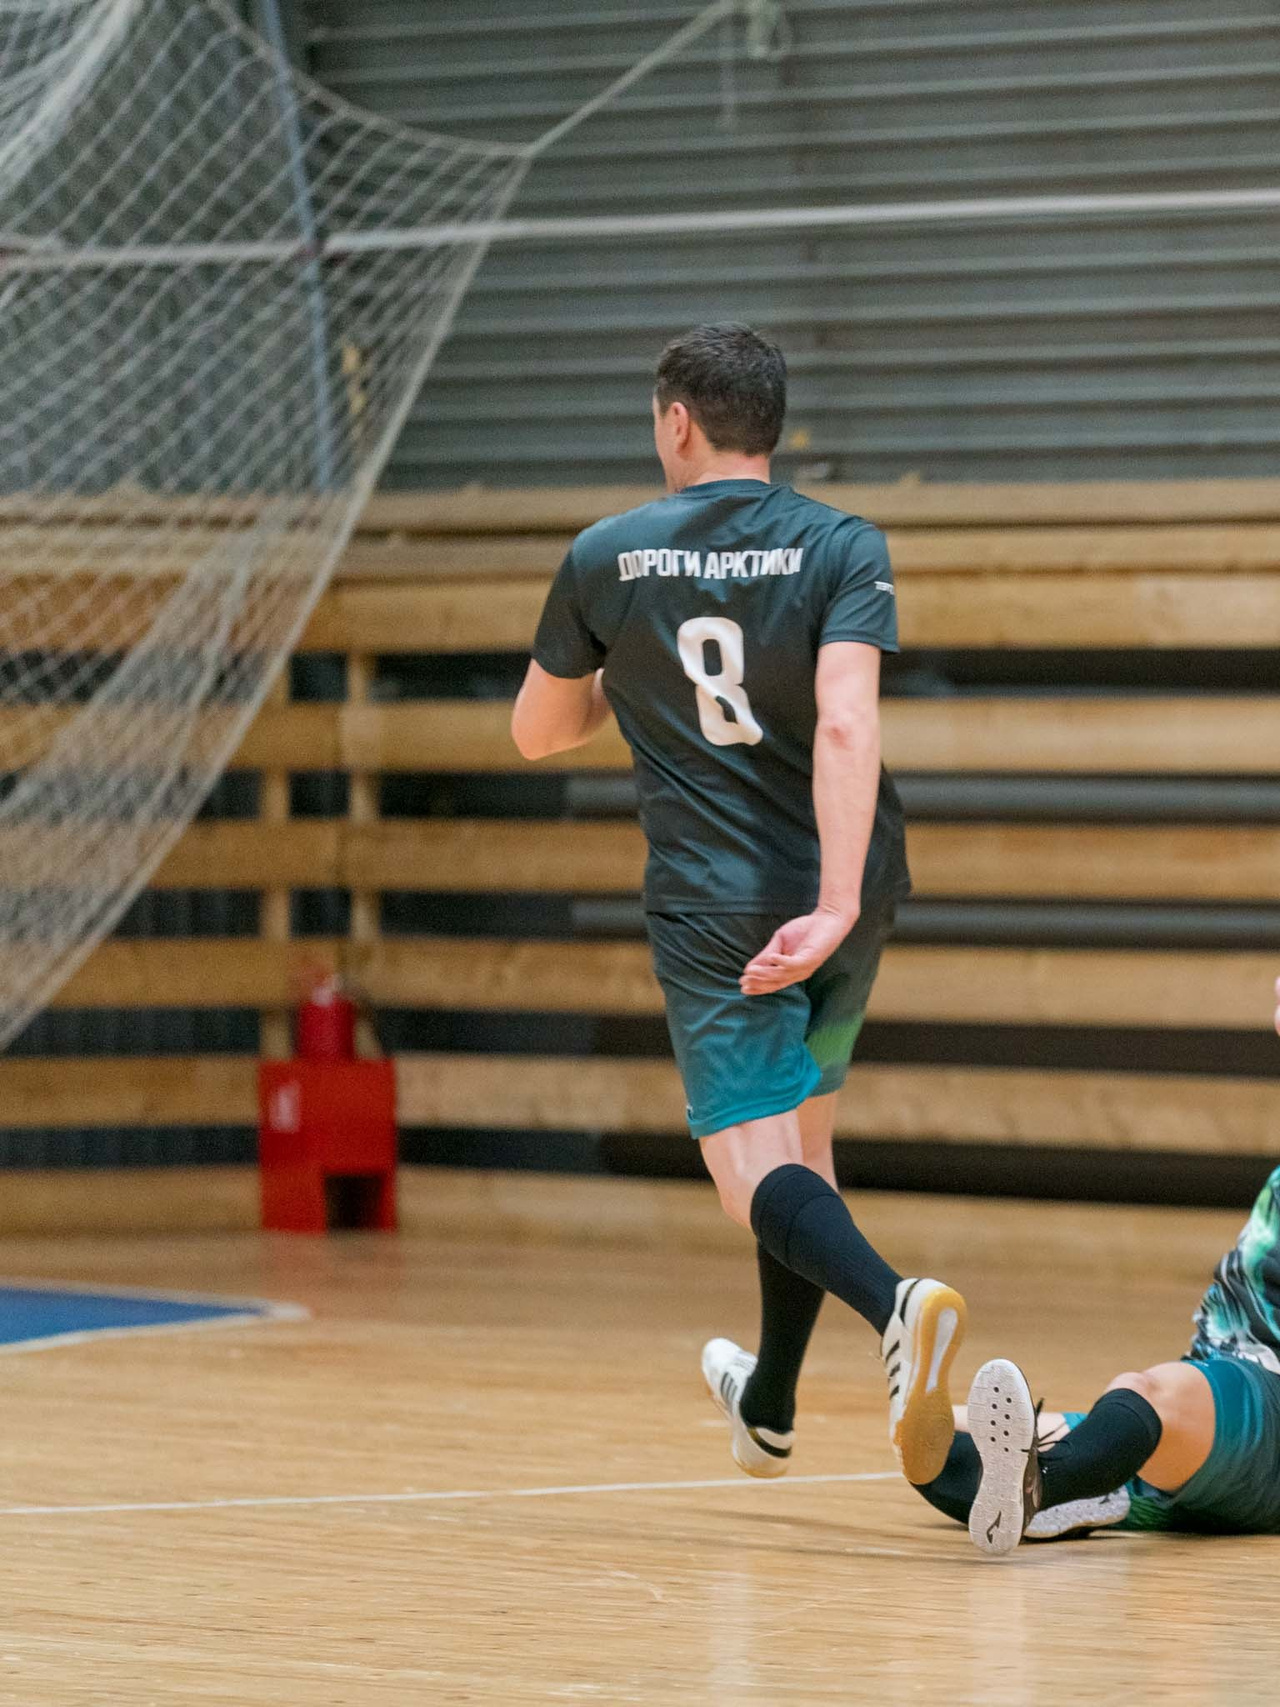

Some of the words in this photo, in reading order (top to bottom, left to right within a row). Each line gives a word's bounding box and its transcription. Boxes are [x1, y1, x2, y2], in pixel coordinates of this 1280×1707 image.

[617, 548, 700, 581] ДОРОГИ
[703, 547, 804, 579] АРКТИКИ
[677, 616, 763, 745] 8
